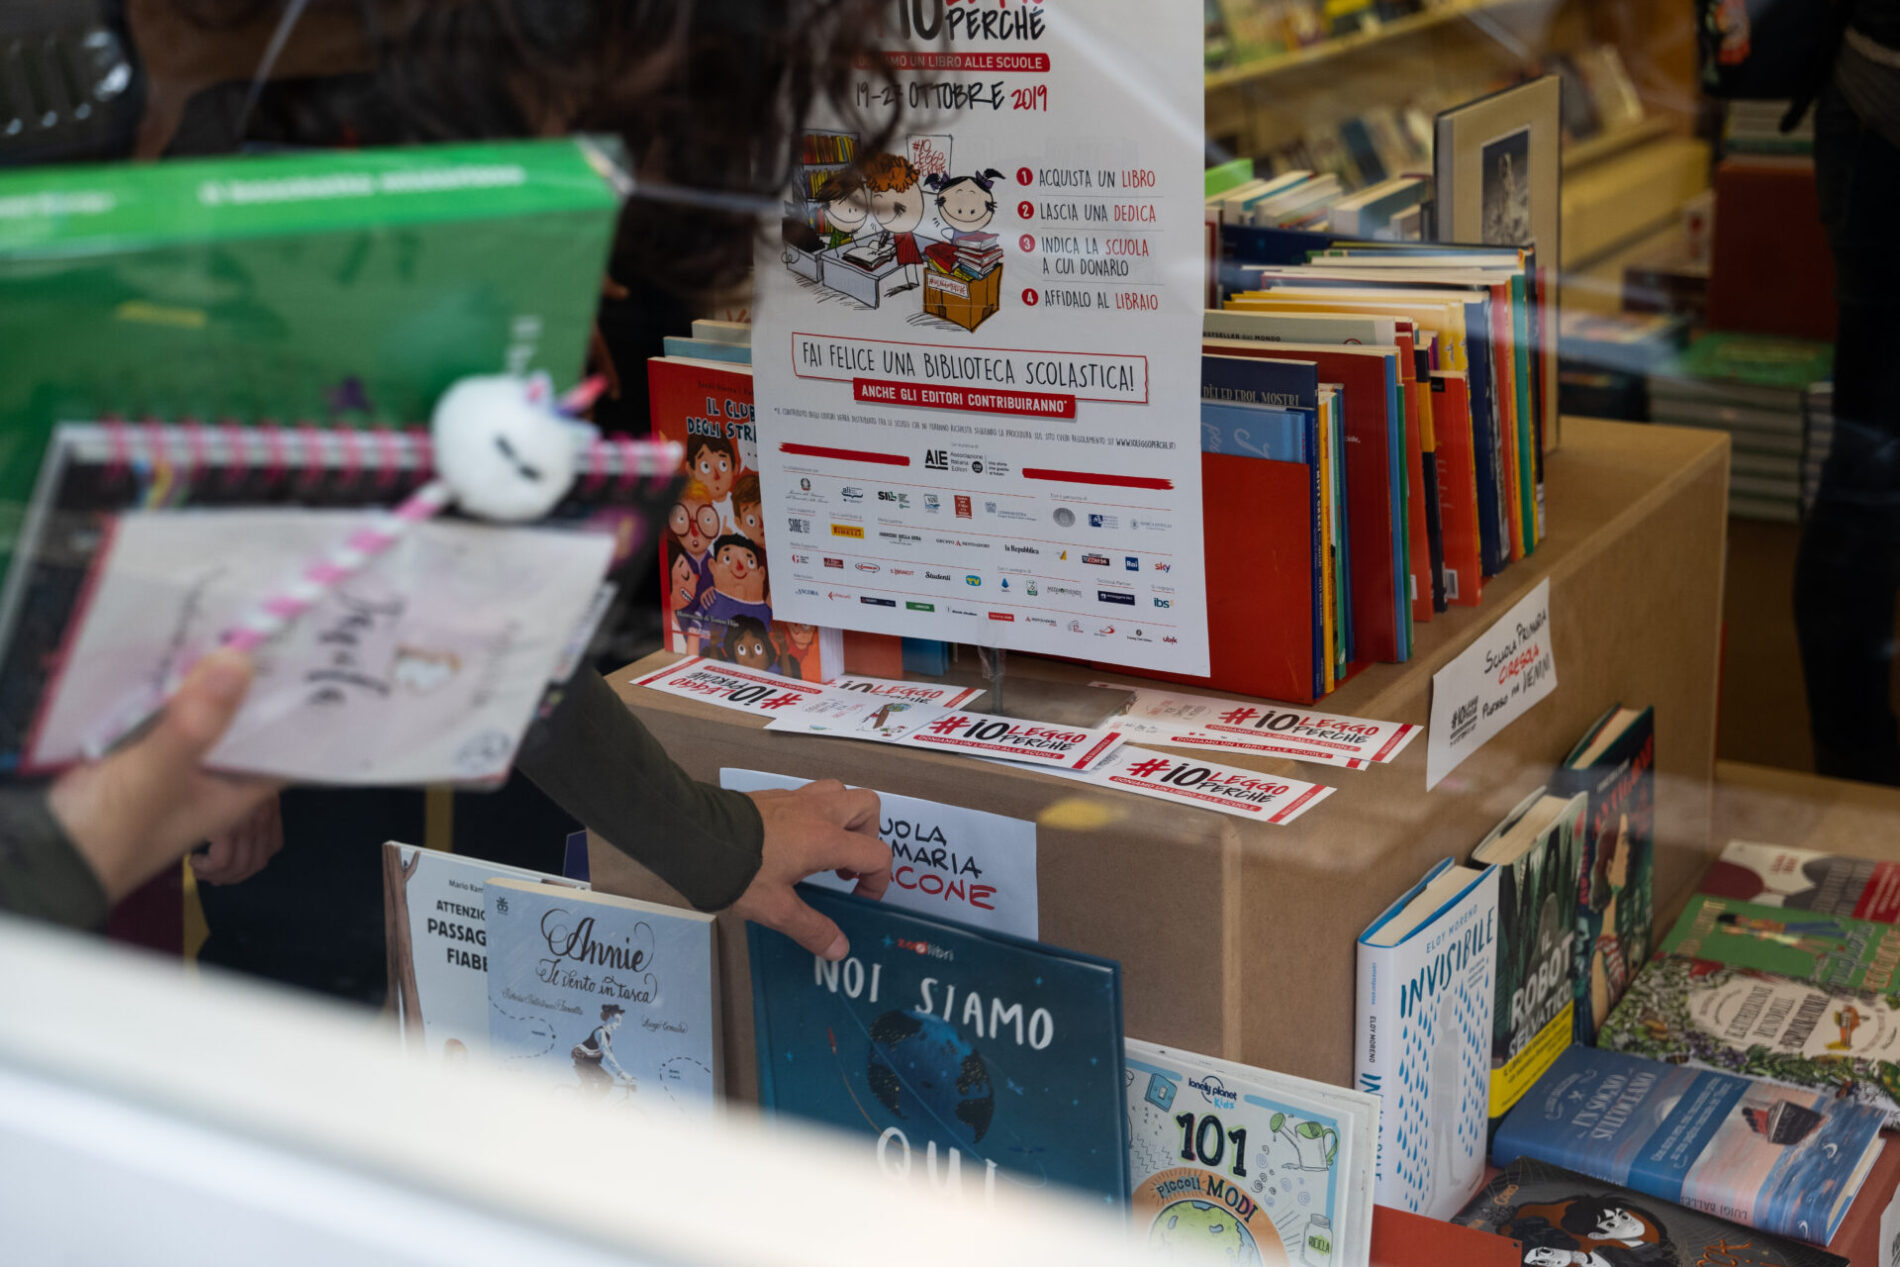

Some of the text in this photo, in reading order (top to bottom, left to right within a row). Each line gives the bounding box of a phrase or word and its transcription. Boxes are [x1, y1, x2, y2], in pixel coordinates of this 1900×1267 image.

[928, 57, 962, 68] LIBRO
[964, 58, 993, 68] ALLE
[996, 59, 1043, 69] SCUOLE
[909, 81, 1005, 111] OTTOBRE
[1011, 84, 1048, 112] 2019
[1040, 169, 1092, 188] ACQUISTA
[1099, 170, 1115, 187] UN
[1121, 169, 1156, 188] LIBRO
[1040, 203, 1078, 221] LASCIA
[1084, 204, 1108, 222] UNA
[1114, 205, 1156, 223] DEDICA
[1041, 236, 1079, 254] INDICA
[1086, 237, 1099, 254] LA
[1105, 239, 1149, 256] SCUOLA
[1043, 257, 1129, 276] A CUI DONARLO
[1045, 290, 1091, 308] AFFIDALO
[1098, 292, 1109, 308] AL
[1115, 292, 1159, 311] LIBRAIO
[803, 342, 1134, 392] FAI FELICE UNA BIBLIOTECA SCOLASTICA!
[862, 385, 896, 399] ANCHE
[901, 388, 917, 401] GLI
[922, 390, 963, 406] EDITORI
[1261, 391, 1299, 407] MOSTRI
[706, 397, 755, 422] IL CLUB
[686, 416, 721, 438] DEGLI
[925, 449, 948, 466] AIE
[1010, 545, 1039, 555] Repubblica
[925, 571, 951, 581] Studenti
[1154, 562, 1171, 573] sky
[870, 684, 944, 699] LEGGO
[1007, 725, 1087, 743] LEGGO
[1298, 716, 1380, 735] LEGGO
[1207, 771, 1290, 795] LEGGO
[879, 818, 947, 846] UOLA
[892, 840, 983, 879] MARIA
[448, 879, 468, 891] Mario
[427, 918, 487, 947] PASSAG
[540, 908, 655, 973] Annie
[1426, 904, 1478, 954] ELOY MORENO
[1541, 931, 1552, 955] IL
[1400, 906, 1495, 1019] INVISIBILE
[598, 976, 615, 997] in
[617, 972, 658, 1004] tasca
[1511, 930, 1575, 1032] ROBOT
[814, 955, 1054, 1050] NOI SIAMO
[1369, 1016, 1377, 1034] ELOY
[1188, 1078, 1237, 1101] lonely planet
[1571, 1073, 1628, 1128] UN SOGNO
[1175, 1112, 1247, 1178] 101
[876, 1126, 998, 1200] QUI
[1206, 1175, 1259, 1224] MODI
[1680, 1196, 1748, 1220] LUIGI BALLE
